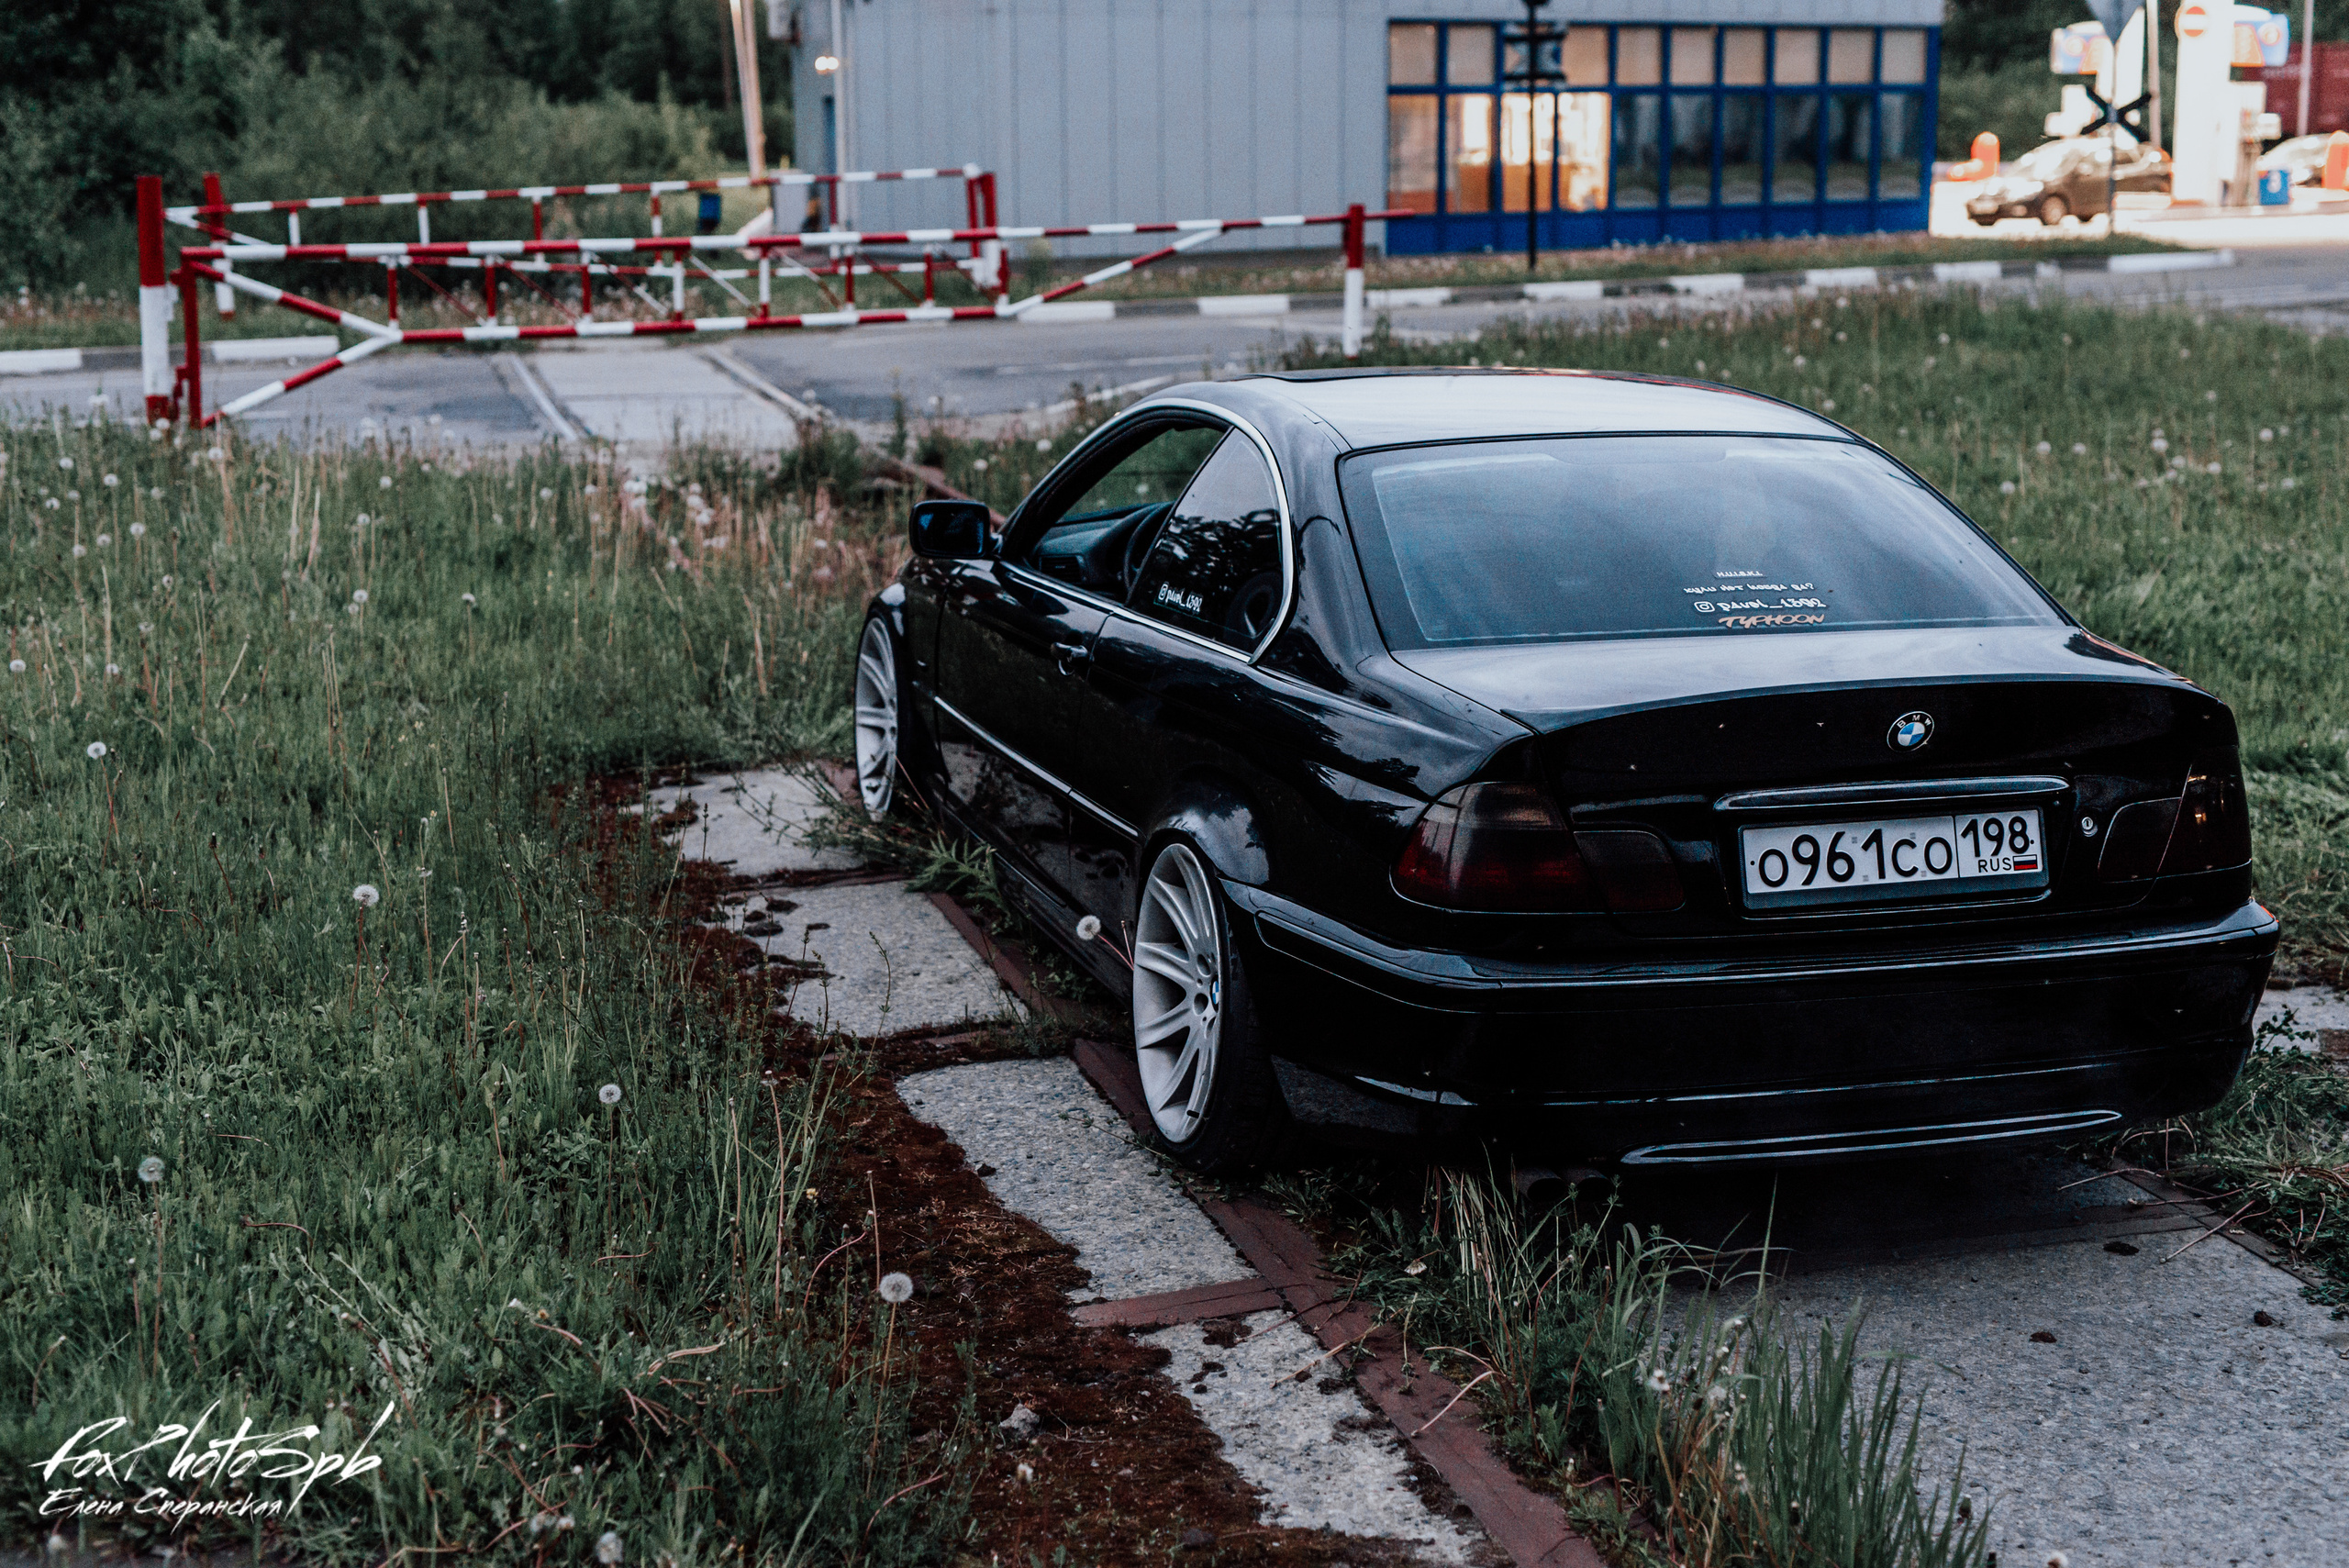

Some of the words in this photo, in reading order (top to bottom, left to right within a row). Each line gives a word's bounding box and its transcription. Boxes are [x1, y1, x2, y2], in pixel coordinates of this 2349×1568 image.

[1719, 614, 1824, 628] TYPHOON
[1897, 715, 1932, 728] BMW
[1961, 816, 2030, 858] 198
[1978, 857, 2012, 873] RUS
